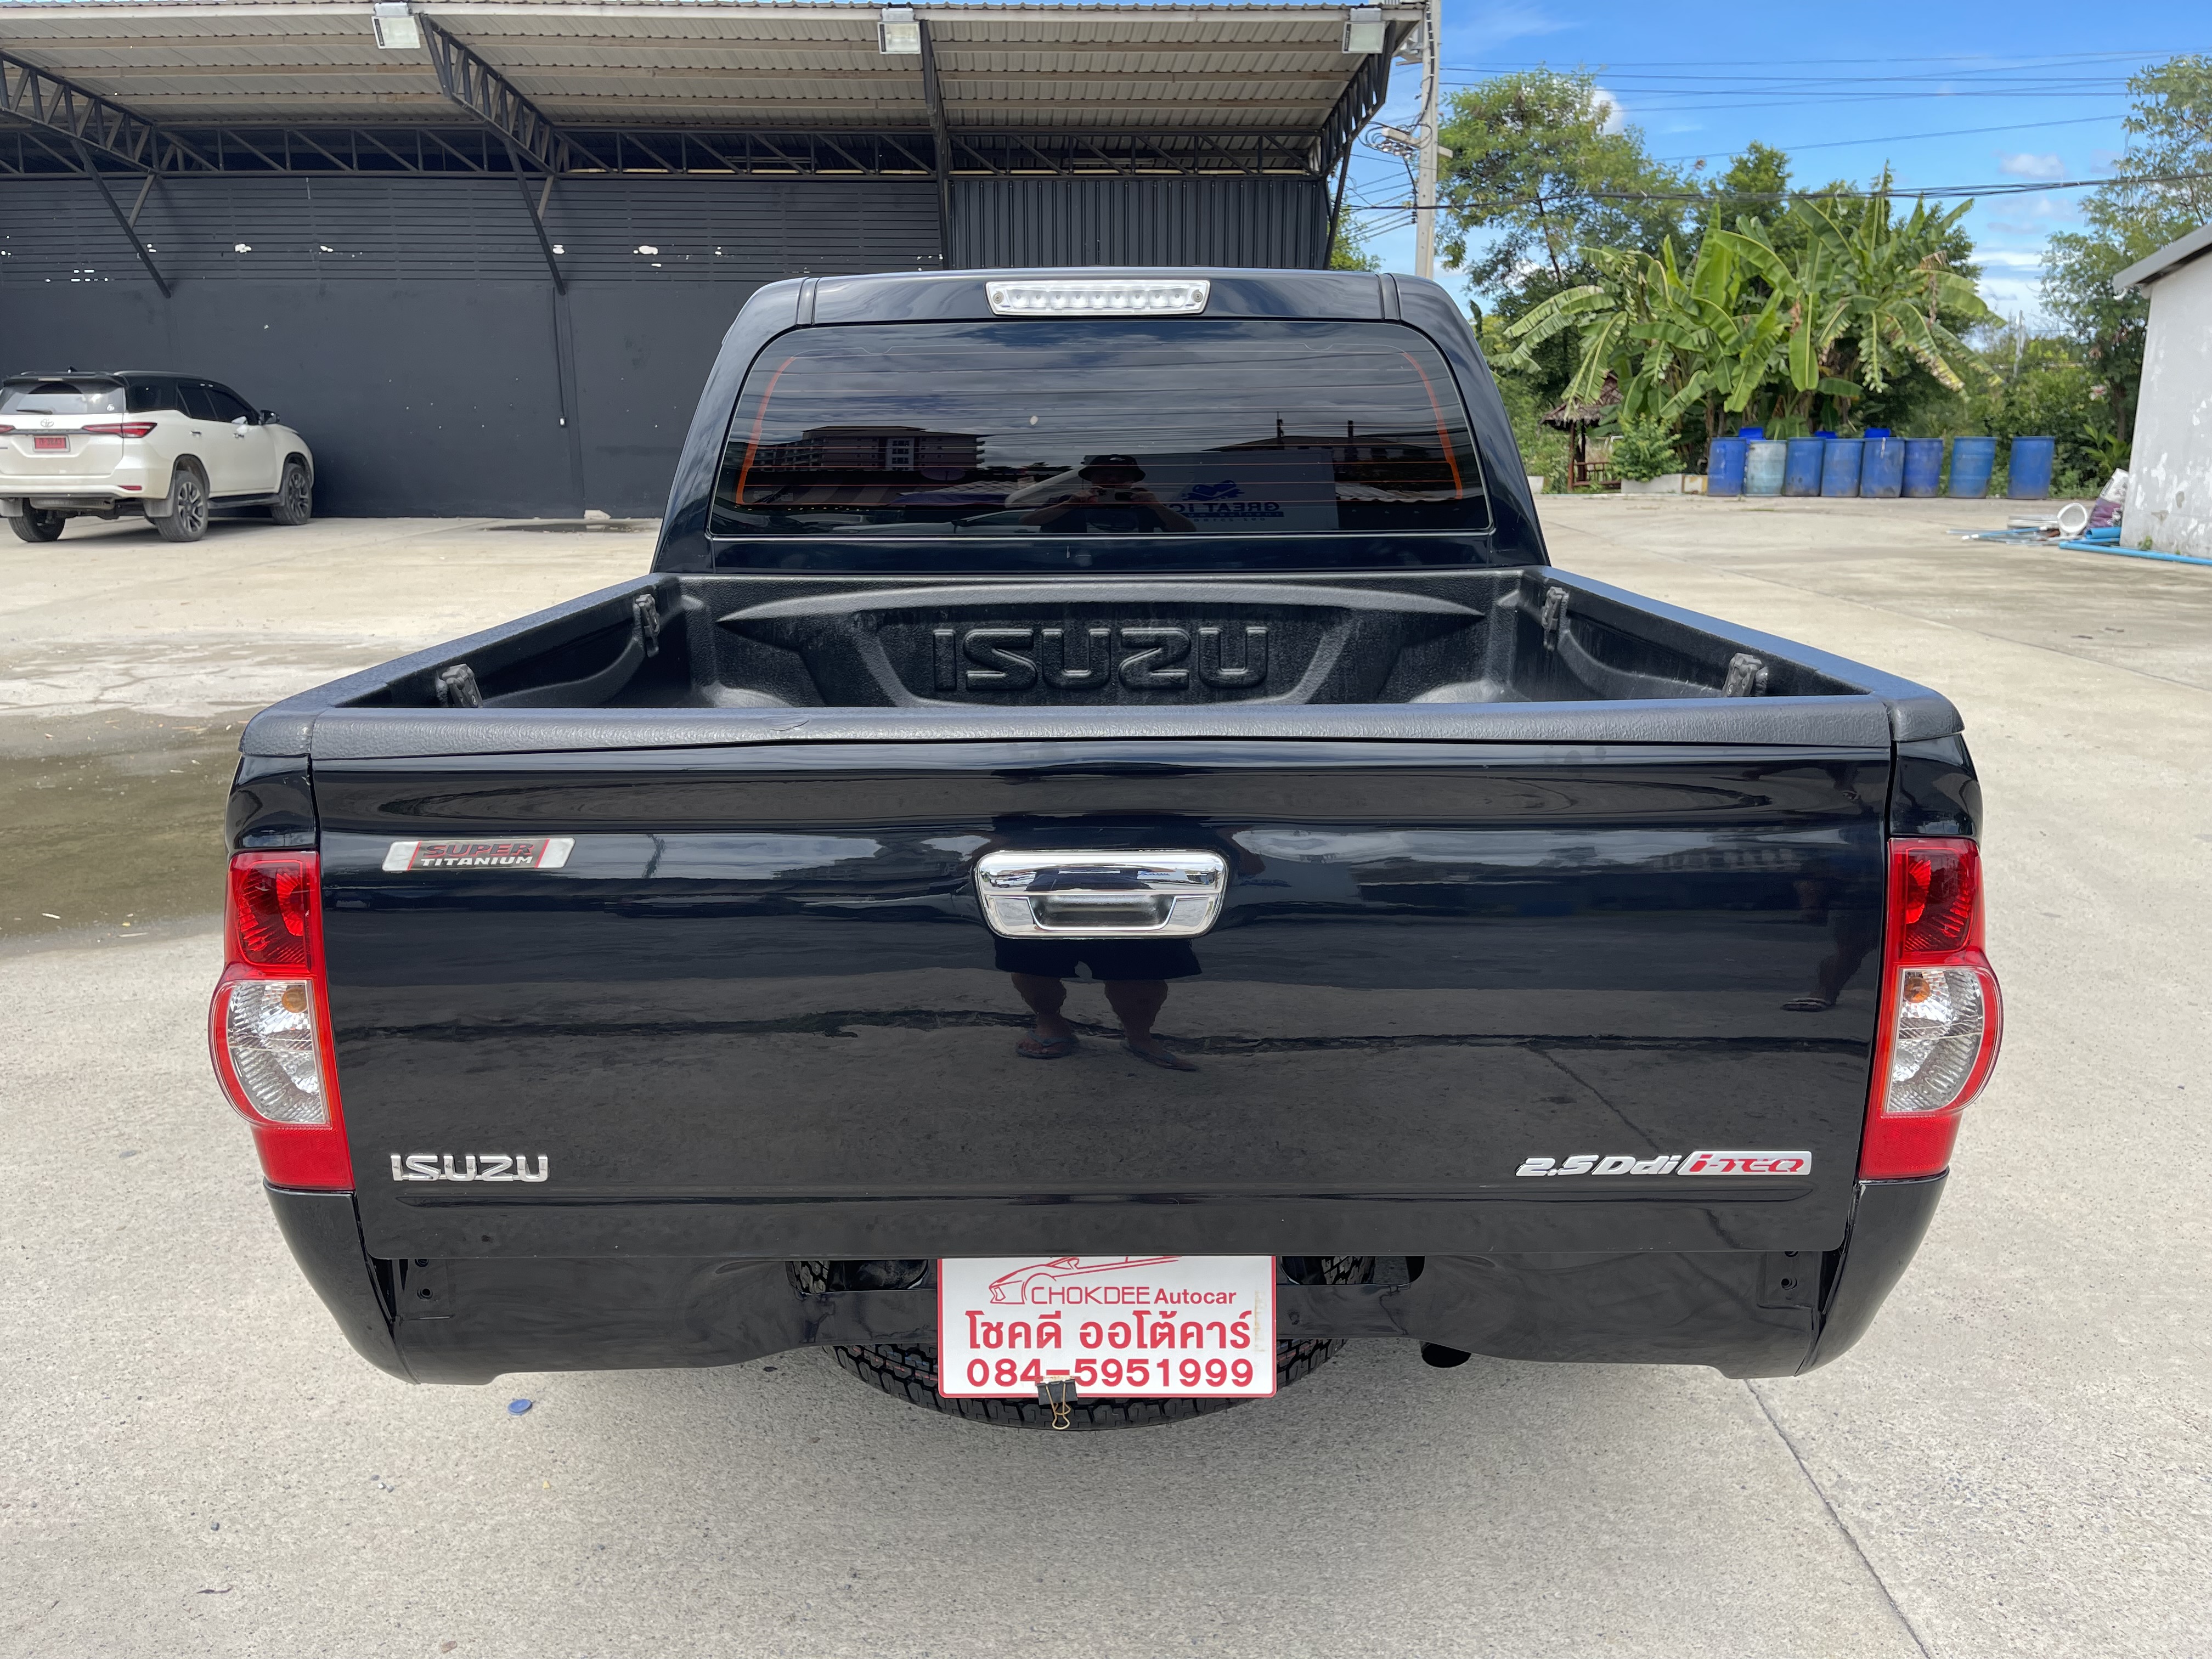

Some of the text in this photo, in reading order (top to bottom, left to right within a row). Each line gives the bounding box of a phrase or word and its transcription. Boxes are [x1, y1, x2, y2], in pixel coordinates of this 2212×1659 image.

[933, 627, 1268, 690] ISUZU
[421, 856, 533, 867] TITANIUM
[423, 843, 534, 856] SUPER
[390, 1155, 548, 1182] ISUZU
[1031, 1286, 1237, 1305] CHOKDEE Autocar
[965, 1310, 1252, 1349] โชคดี ออโต้คาร์
[966, 1358, 1254, 1387] 084-5951999
